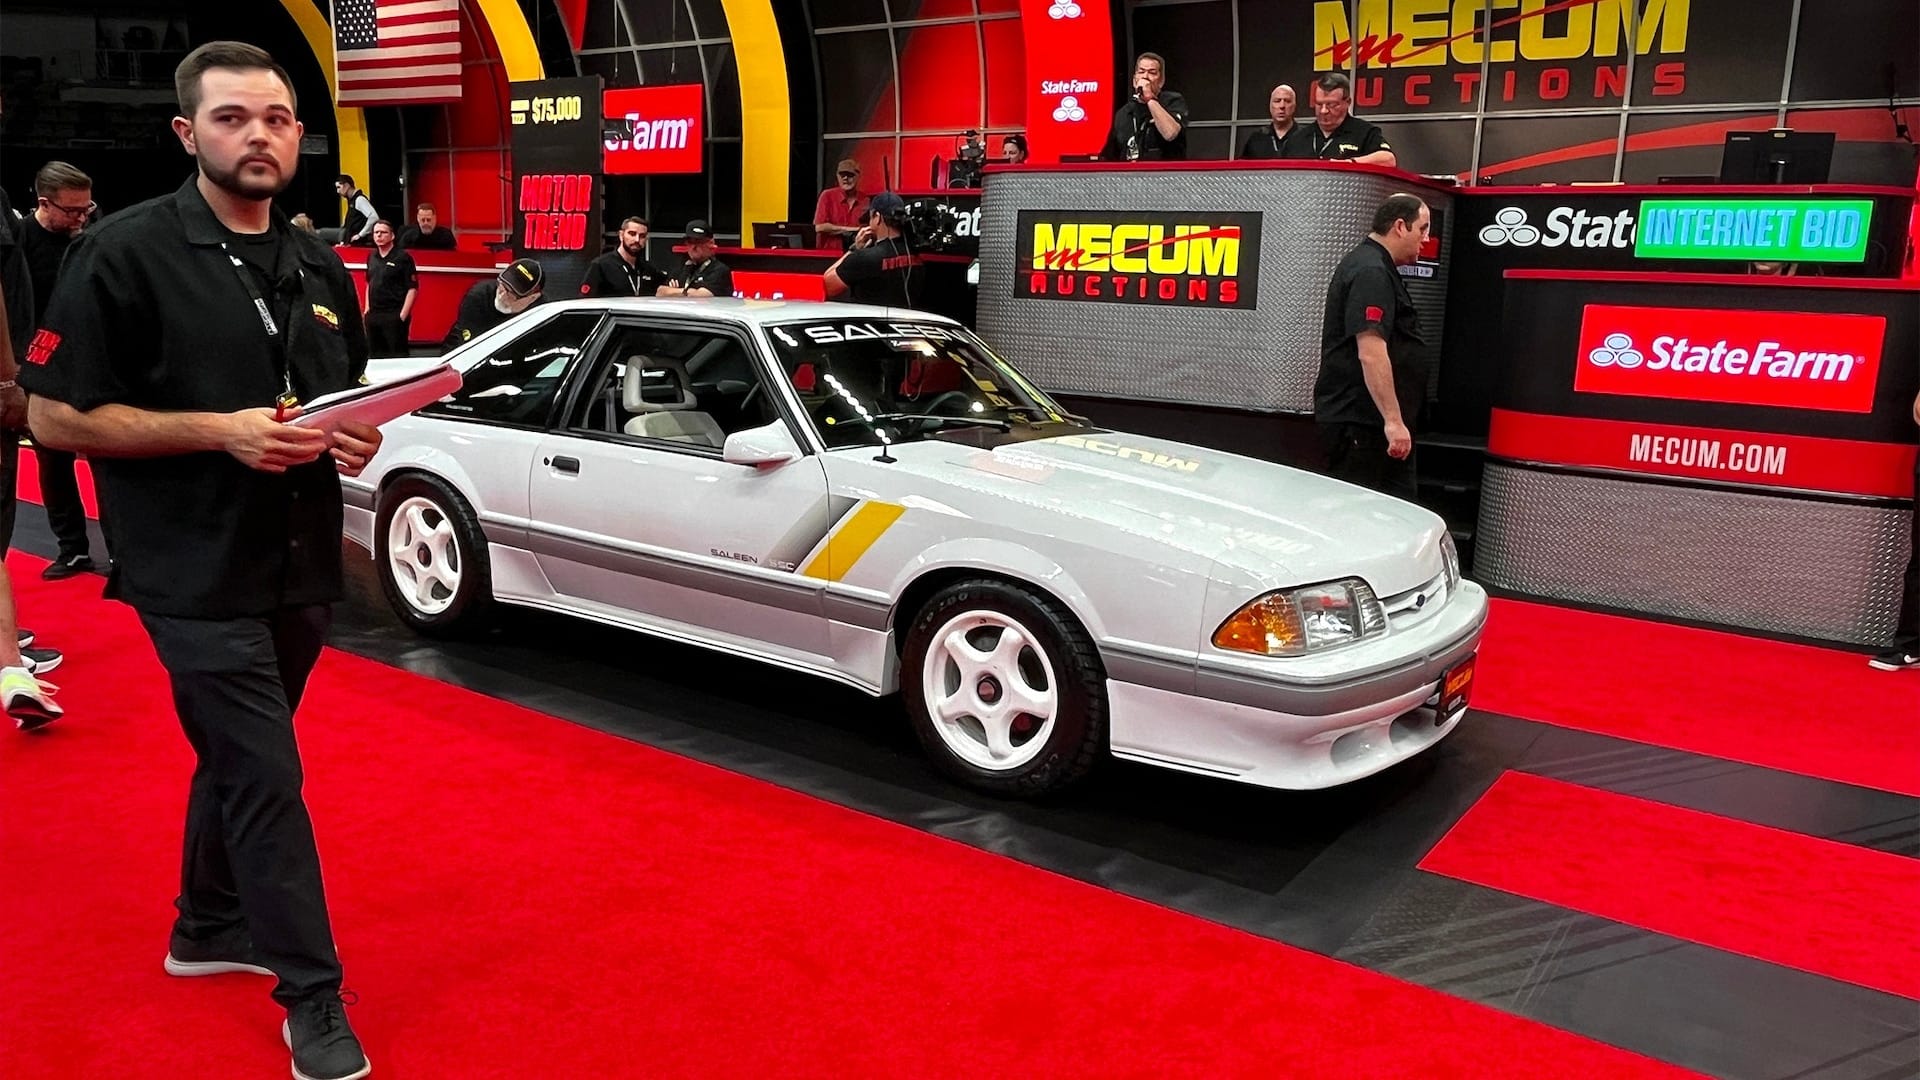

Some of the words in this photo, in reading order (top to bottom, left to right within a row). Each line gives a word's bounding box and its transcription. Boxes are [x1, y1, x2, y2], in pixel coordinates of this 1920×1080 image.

[1313, 0, 1690, 71] MECUM
[532, 96, 581, 124] $75,000
[520, 175, 592, 212] MOTOR
[524, 213, 587, 250] TREND
[1540, 206, 1636, 248] Stat
[1644, 208, 1796, 247] INTERNET
[1801, 209, 1862, 249] BID
[1033, 223, 1241, 277] MECUM
[1030, 274, 1238, 303] AUCTIONS
[805, 323, 969, 345] SALEEN
[1629, 434, 1787, 475] MECUM.COM
[710, 548, 758, 564] SALEEN
